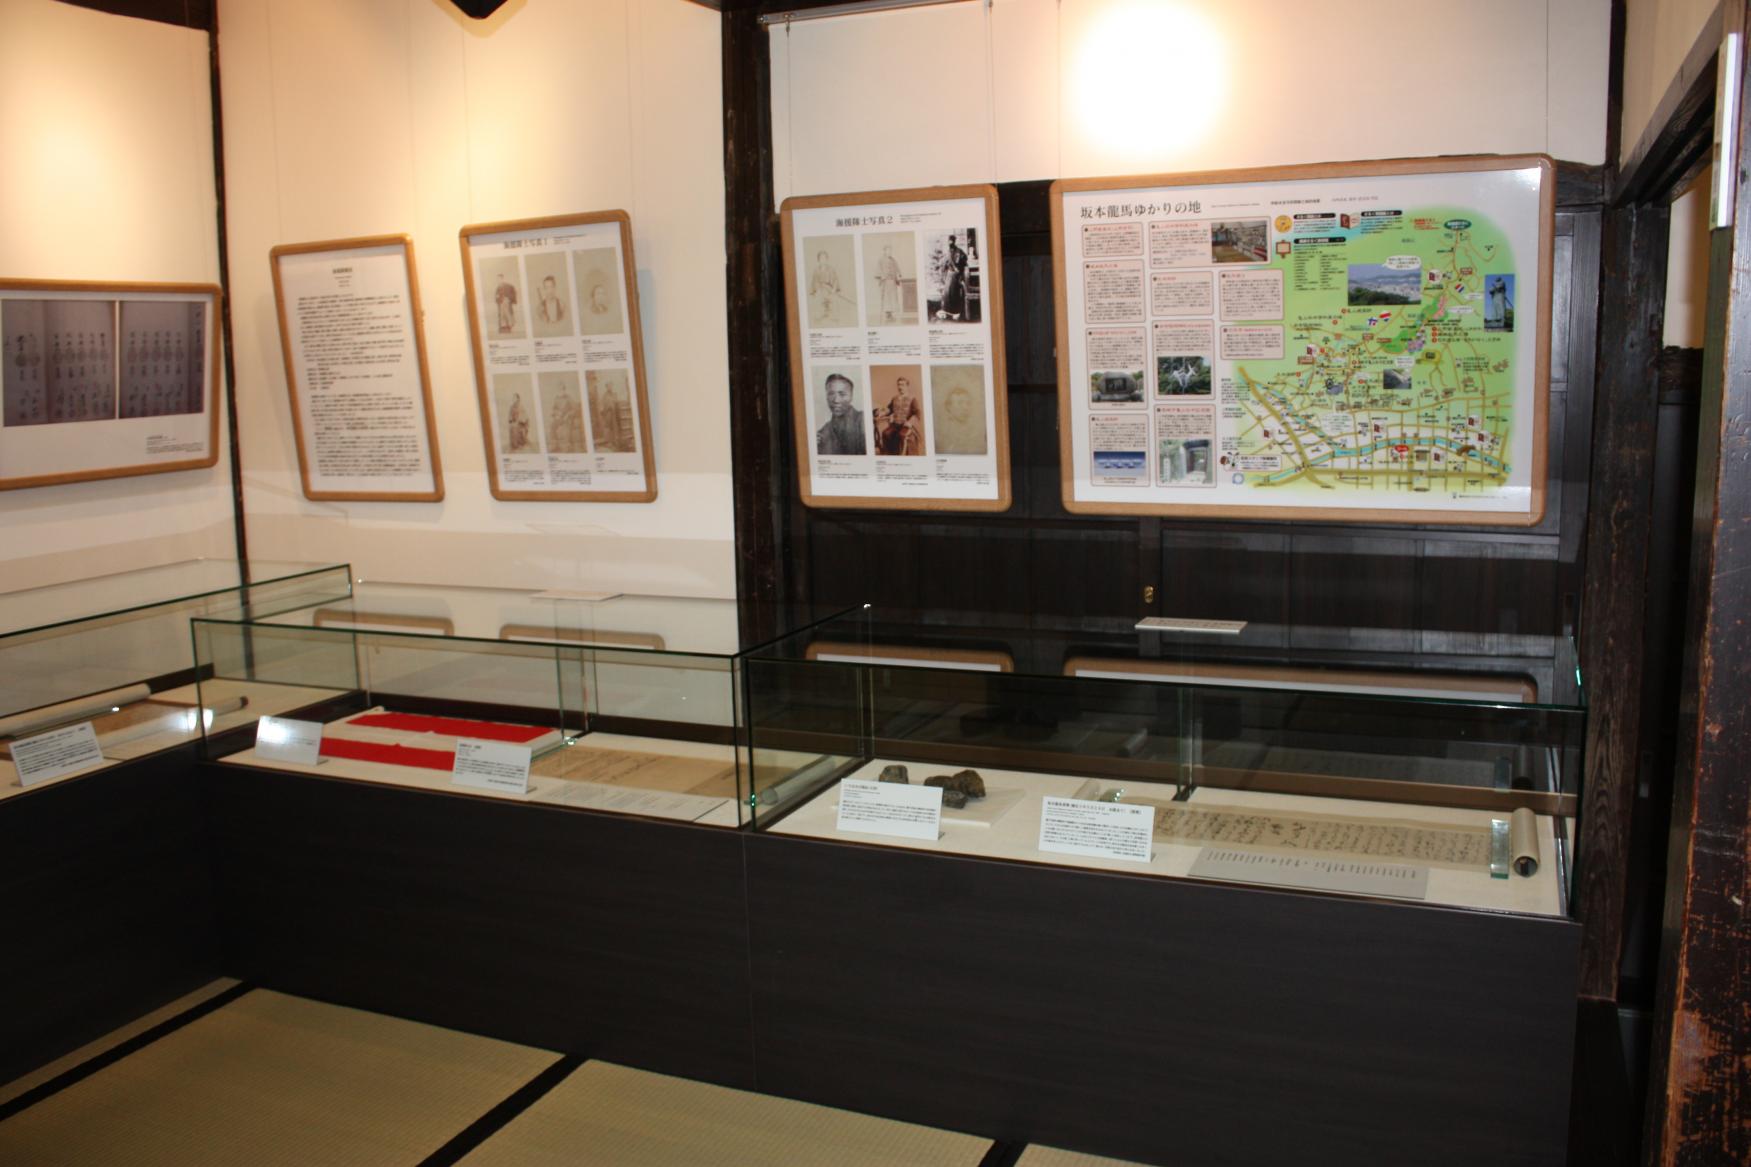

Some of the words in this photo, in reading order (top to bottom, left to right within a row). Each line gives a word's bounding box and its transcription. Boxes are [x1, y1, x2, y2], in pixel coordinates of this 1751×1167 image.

[1080, 200, 1201, 219] 坂本龍馬ゆかりの地
